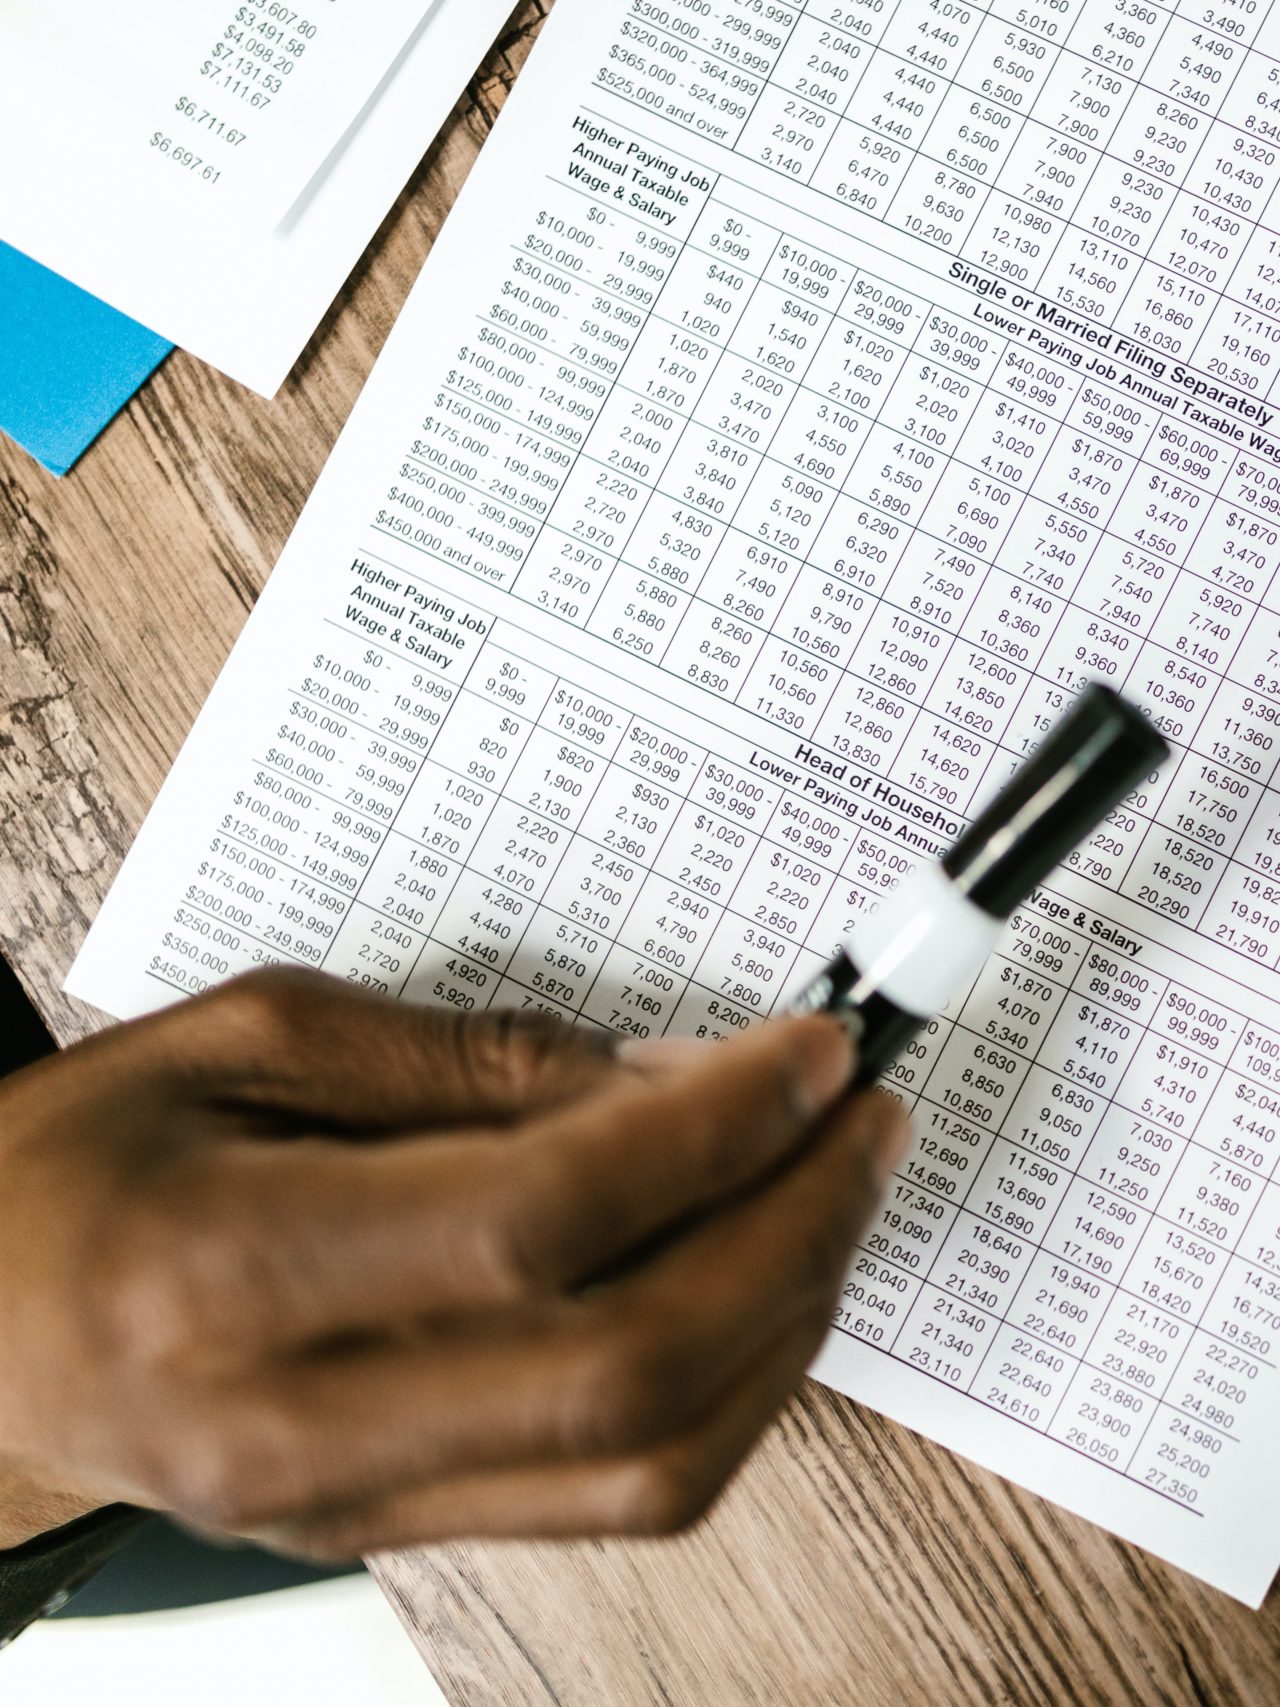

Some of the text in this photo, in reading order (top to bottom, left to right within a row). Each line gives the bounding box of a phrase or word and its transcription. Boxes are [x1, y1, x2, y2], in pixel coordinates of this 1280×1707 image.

[223, 24, 293, 74] $4,098.20
[235, 6, 305, 57] $3,491.58
[247, 0, 316, 38] 3,607.80
[818, 31, 860, 58] 2,040
[200, 60, 270, 109] $7,111.67
[211, 42, 281, 93] $7,131.53
[711, 37, 769, 72] 319,999
[174, 96, 246, 145] $6,711.67
[687, 83, 746, 119] 524,999
[699, 60, 758, 96] 364,999
[859, 136, 900, 163] 5,920
[149, 131, 220, 183] $6,697.61
[571, 115, 709, 191] Higher Paying Job
[571, 141, 688, 206] Annual Taxable
[596, 67, 664, 108] $525,000
[665, 104, 692, 122] and
[696, 119, 728, 139] over
[760, 147, 802, 174] 3,140
[836, 182, 877, 209] 6,840
[905, 214, 952, 245] 10,200
[567, 161, 676, 226] Wage & Salary
[709, 233, 749, 260] 9,999
[782, 267, 829, 298] 19,999
[703, 292, 806, 349] 940 1,540
[706, 264, 893, 362] $440 $940 $1,020
[948, 261, 1274, 427] Single or Married Filing Separately
[972, 302, 1026, 336] Lower
[1026, 328, 1083, 367] Paying
[1085, 357, 1116, 380] Job
[1118, 373, 1179, 409] Annual
[1181, 399, 1244, 441] Taxable
[349, 584, 465, 649] Annual Taxable
[350, 558, 486, 634] Higher Paying Job
[345, 604, 453, 669] Wage & Salary
[466, 760, 495, 782] 930
[478, 737, 507, 759] 820
[499, 717, 519, 735] $0
[556, 746, 594, 773] $820
[631, 783, 669, 810] $930
[932, 724, 981, 756] 14,620
[793, 743, 966, 838] Head of Househol
[748, 750, 801, 785] Lower
[802, 777, 859, 817] Paying
[860, 808, 892, 831] Job
[894, 825, 949, 862] Annua
[1072, 911, 1086, 928] &
[1089, 919, 1143, 956] Salary
[909, 772, 957, 804] 15,790
[1137, 885, 1189, 919] 20,290
[433, 981, 932, 1243] 5,920 19,090
[943, 1088, 992, 1122] 10,850
[961, 1068, 1004, 1098] 8,850
[919, 1137, 968, 1171] 12,690
[895, 1185, 1022, 1259] 17,340 18,640
[908, 1346, 1197, 1502] 23,110 24,610 26,050 27,350
